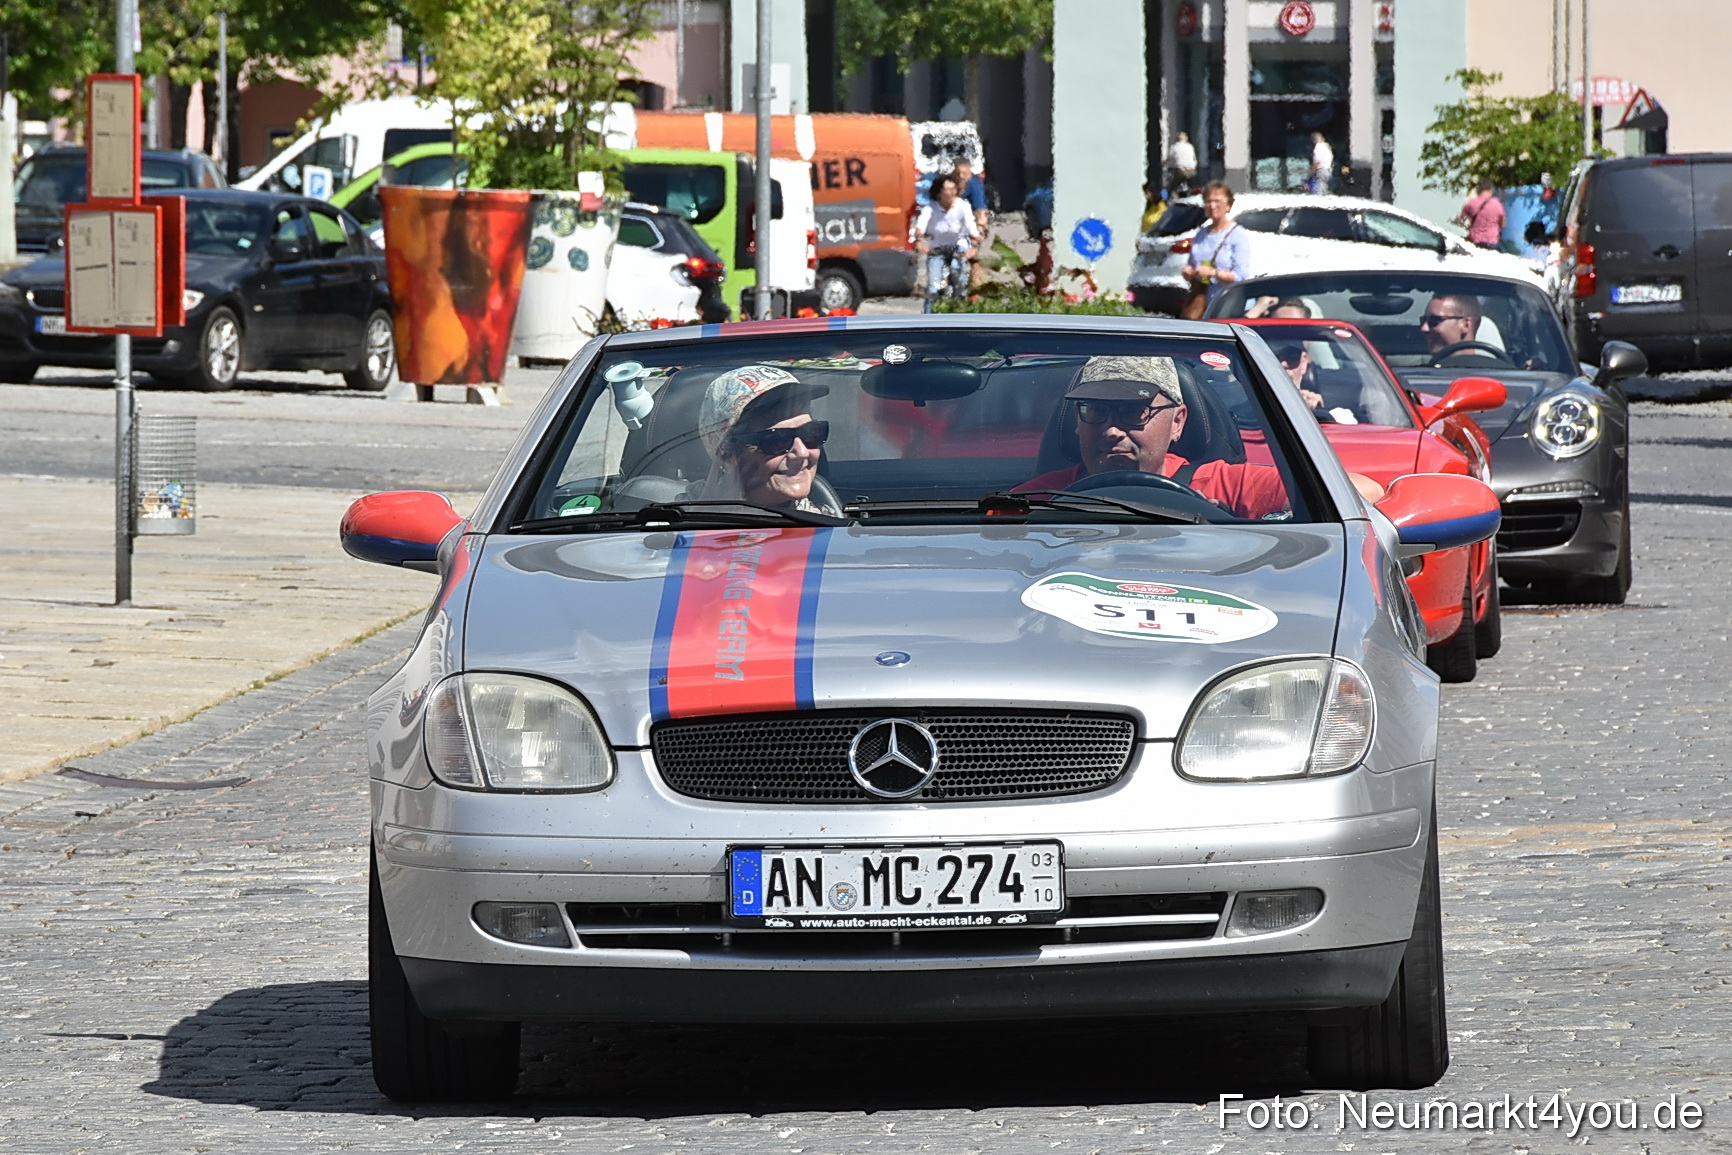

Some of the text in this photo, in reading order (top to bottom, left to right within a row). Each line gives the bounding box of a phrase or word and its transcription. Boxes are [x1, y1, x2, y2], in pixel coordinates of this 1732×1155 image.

[575, 495, 589, 508] 4
[1093, 603, 1196, 625] S11
[1031, 852, 1053, 867] 03
[765, 857, 823, 908] AN
[862, 855, 922, 908] MC
[937, 853, 1025, 907] 274
[742, 890, 754, 906] D
[1033, 889, 1054, 903] 10
[800, 915, 993, 929] www.auto-macht-eckental.de
